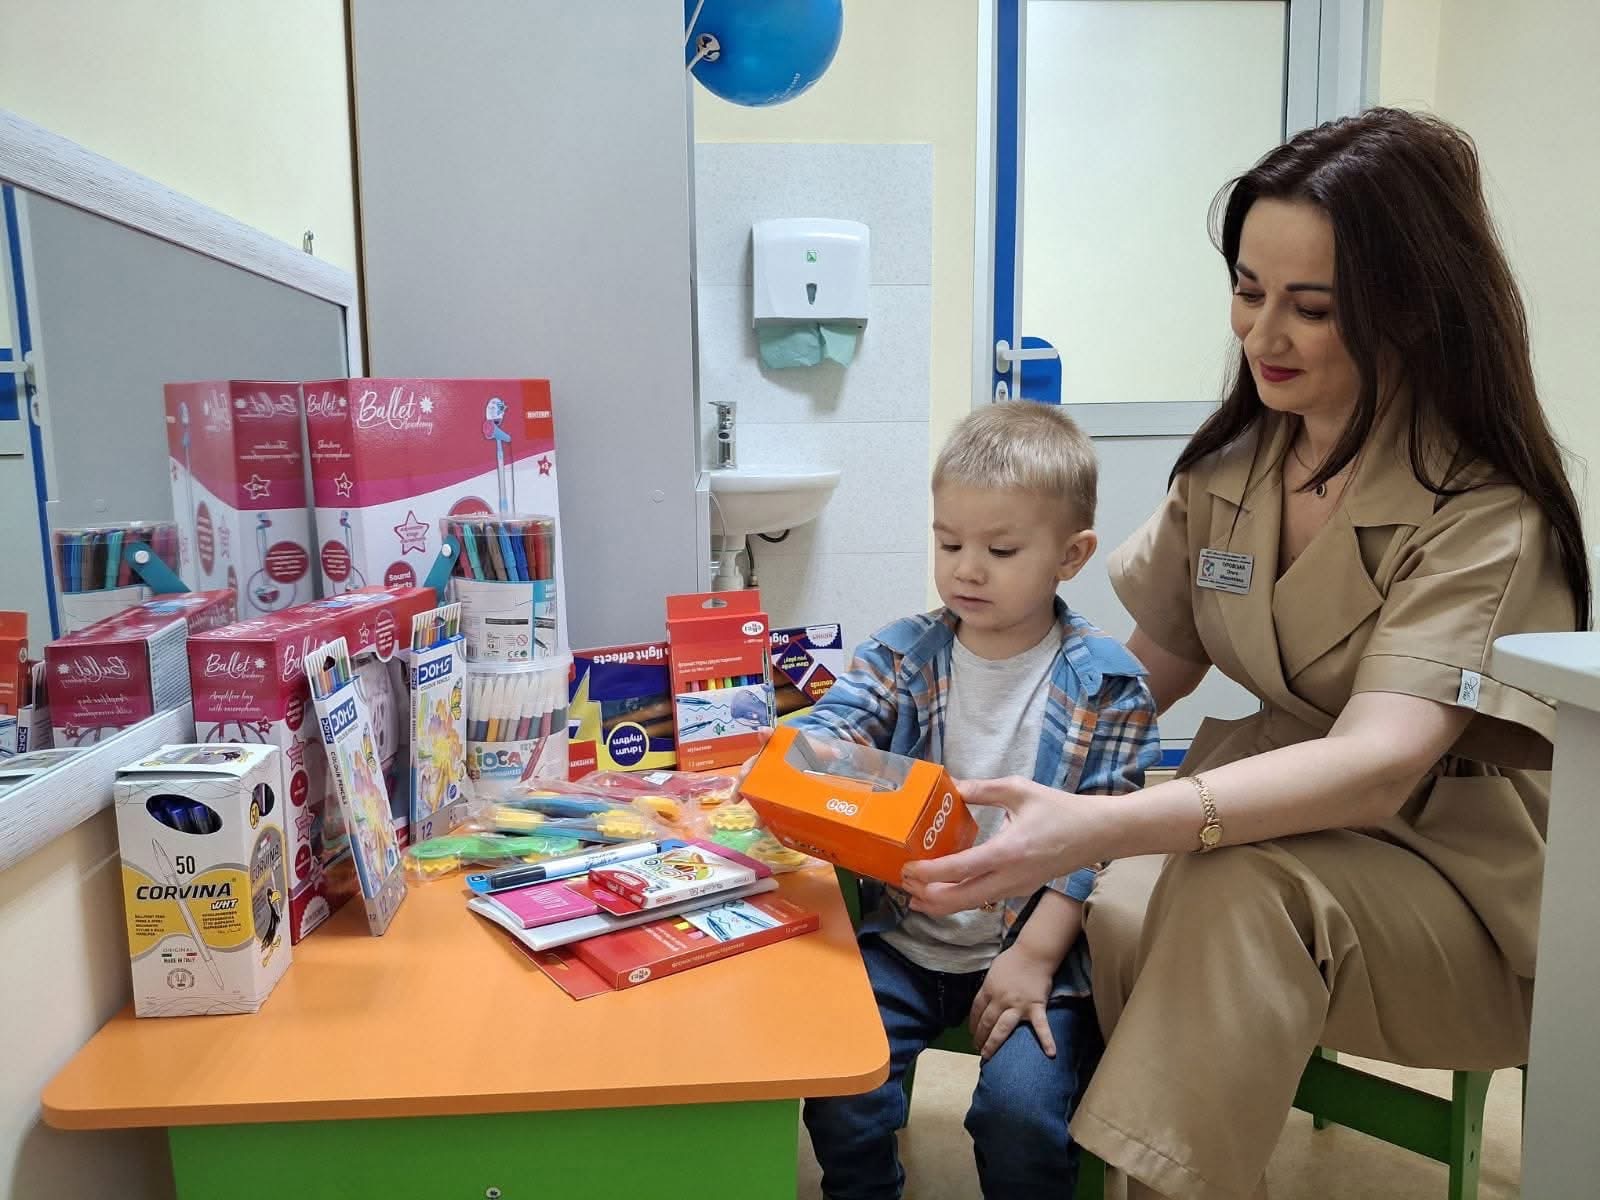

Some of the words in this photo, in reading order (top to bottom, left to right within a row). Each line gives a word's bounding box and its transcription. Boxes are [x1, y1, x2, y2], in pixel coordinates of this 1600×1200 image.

[307, 391, 336, 417] Ballet
[356, 386, 417, 430] Ballet
[400, 415, 433, 435] Academy
[389, 570, 411, 581] Sound
[593, 650, 634, 665] effects
[634, 645, 664, 660] light
[204, 651, 251, 679] Ballet
[419, 656, 450, 682] DOMS
[810, 679, 834, 689] sounds
[330, 698, 357, 735] DOMS
[612, 733, 643, 746] rhythm
[615, 746, 638, 756] drum
[924, 792, 953, 849] TNT
[422, 821, 432, 840] 12
[175, 855, 195, 875] 50
[251, 843, 280, 883] CORVINA
[136, 882, 232, 900] CORVINA
[210, 899, 239, 911] WHT
